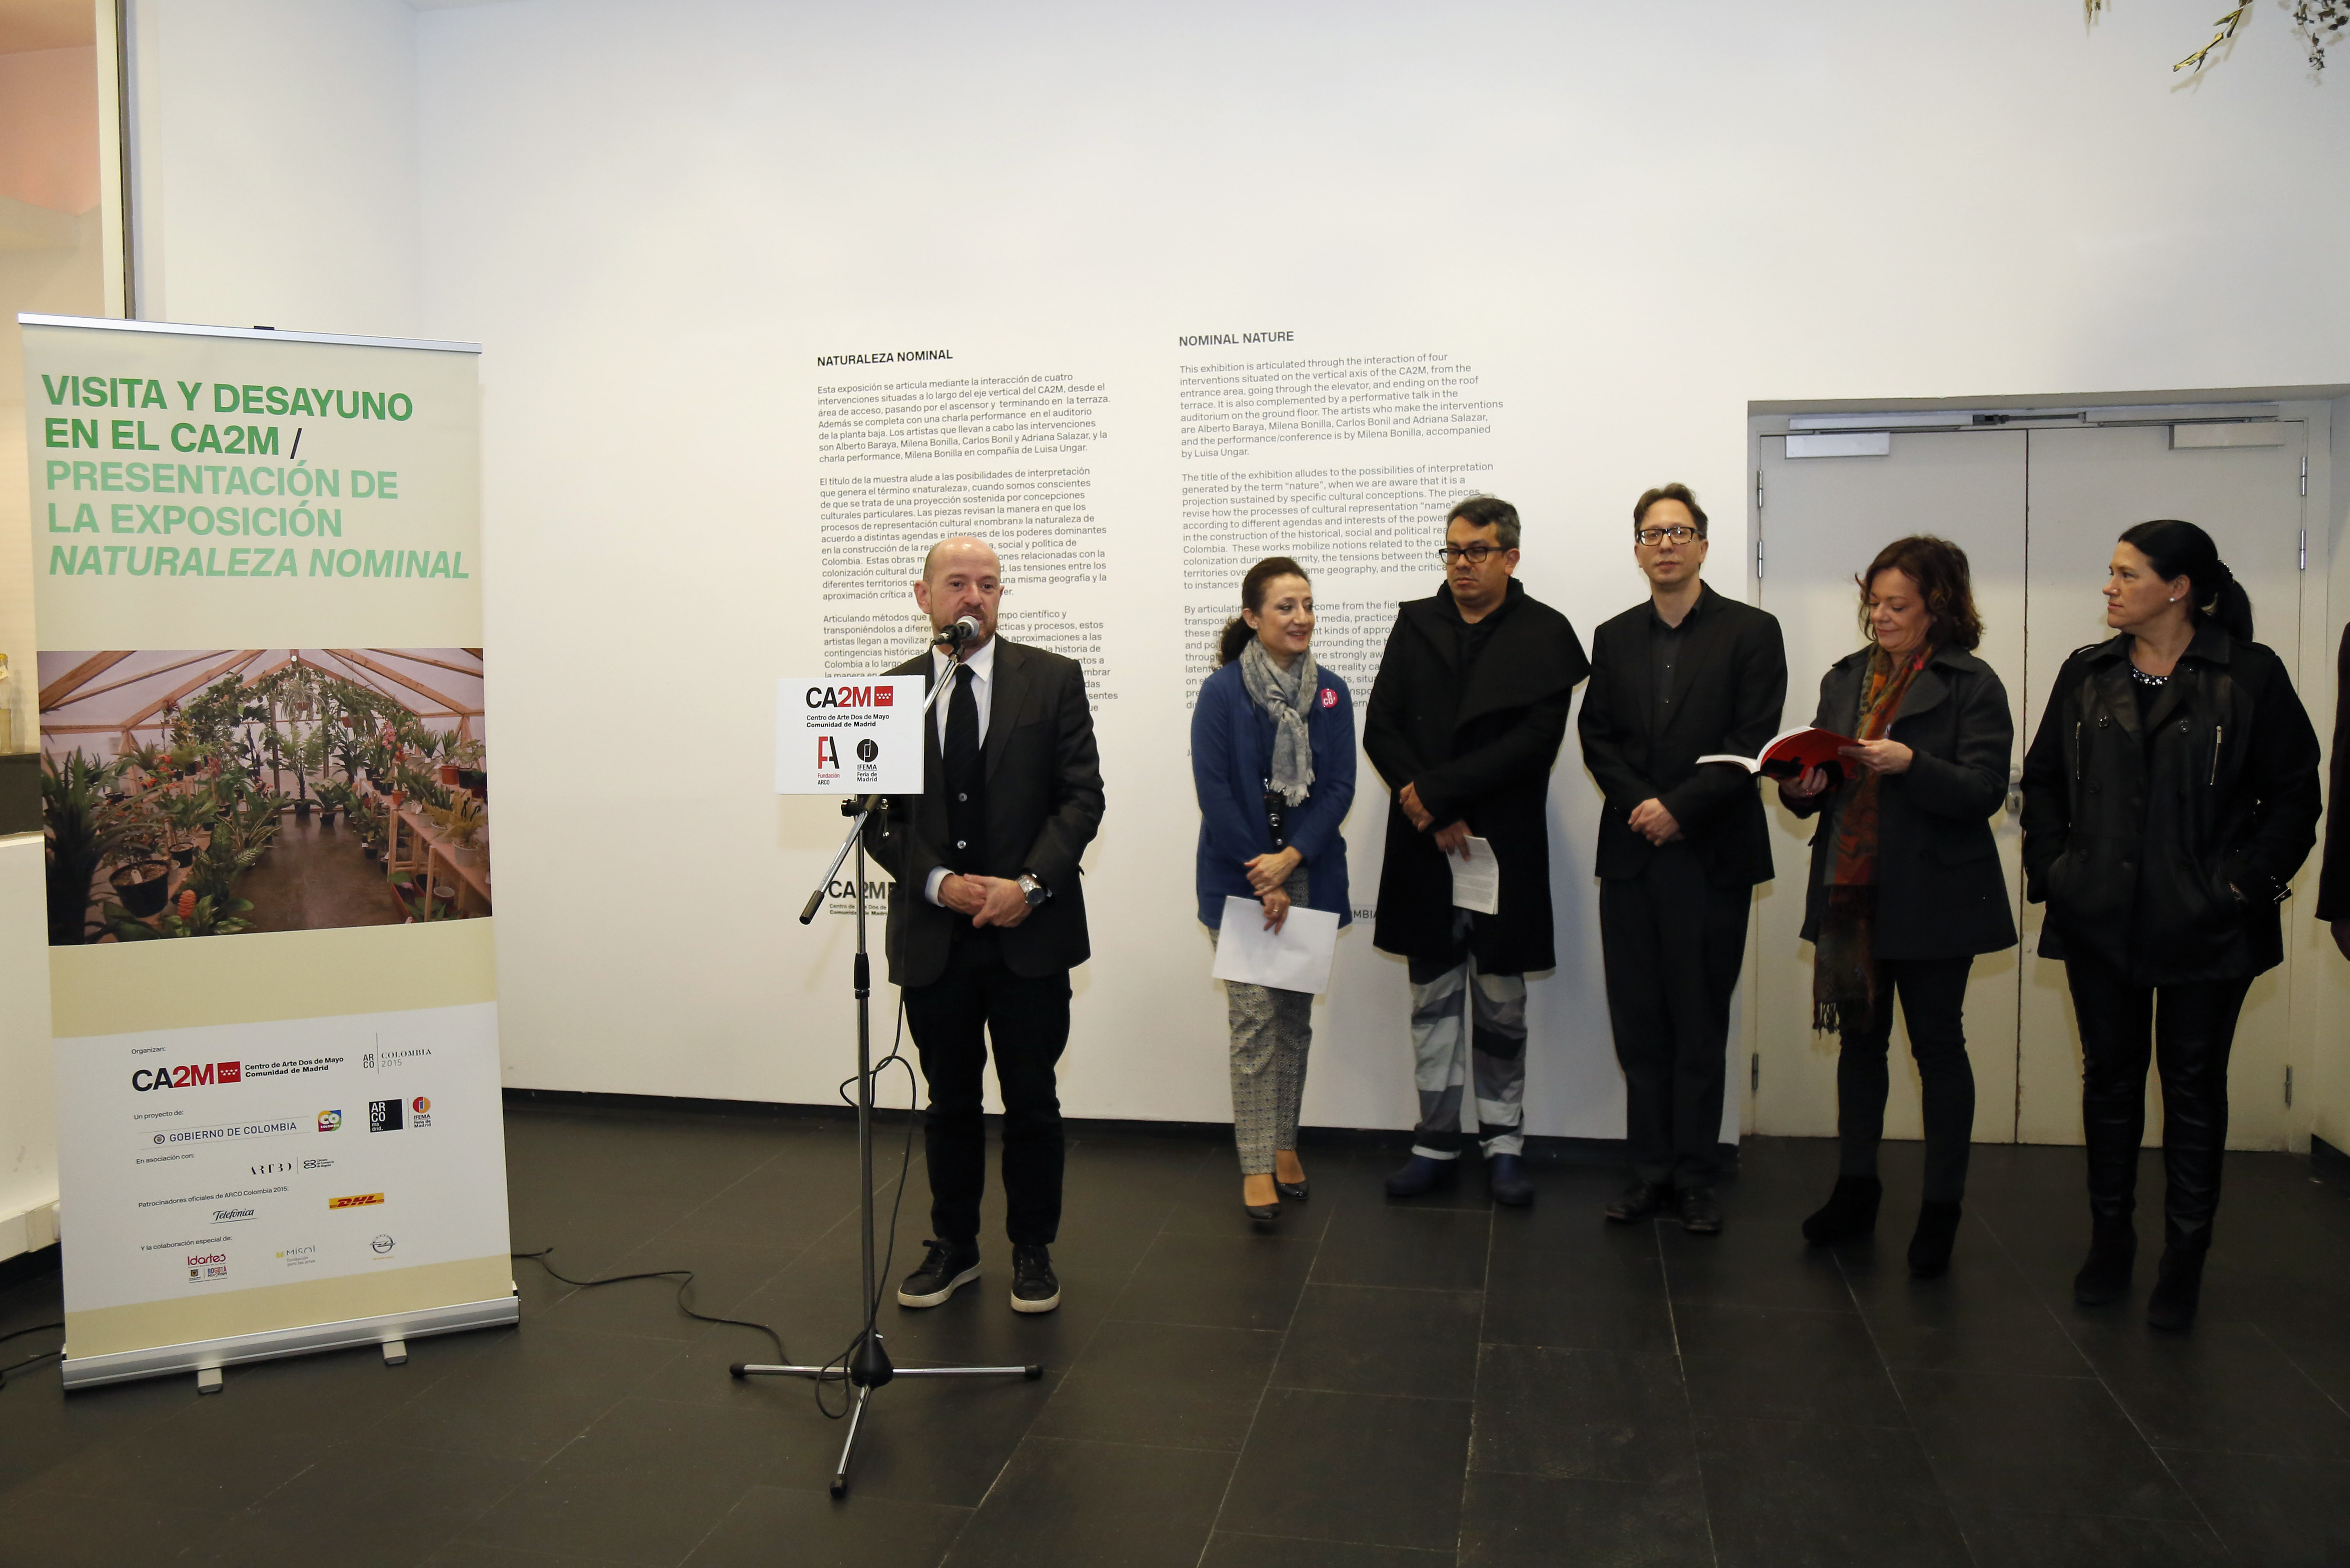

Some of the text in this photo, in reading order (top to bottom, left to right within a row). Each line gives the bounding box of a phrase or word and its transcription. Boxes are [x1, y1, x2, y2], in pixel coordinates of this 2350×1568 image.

[1179, 331, 1294, 346] NOMINAL NATURE
[818, 349, 953, 366] NATURALEZA NOMINAL
[1179, 353, 1448, 373] This exhibition is articulated through the interaction of four
[818, 386, 835, 394] Esta
[837, 383, 882, 394] exposición
[896, 381, 927, 390] articula
[929, 379, 969, 388] mediante
[981, 375, 1029, 385] interacción
[1031, 374, 1042, 383] de
[1044, 373, 1073, 382] cuatro
[41, 374, 413, 422] VISITA Y DESAYUNO
[45, 417, 98, 449] EN
[112, 419, 160, 451] EL
[171, 422, 279, 455] CA2M
[1181, 425, 1491, 446] and the performance/conference is by Milena Bonilla, accompanied
[1182, 448, 1249, 459] by Luisa Ungar.
[46, 459, 398, 499] PRESENTACIÓN DE
[820, 477, 827, 486] El
[829, 477, 850, 485] título
[851, 476, 862, 484] de
[873, 475, 908, 483] muestra
[909, 473, 933, 482] alude
[942, 473, 954, 481] las
[956, 470, 1013, 482] posibilidades
[1015, 469, 1026, 477] de
[1028, 466, 1090, 478] interpretación
[47, 500, 342, 537] LA EXPOSICIÓN
[49, 544, 469, 579] NATURALEZA NOMINAL
[1342, 602, 1364, 610] from
[1366, 601, 1381, 609] the
[823, 613, 927, 623] Articulando métodos que
[824, 638, 855, 646] artistas
[857, 637, 882, 647] llegan
[806, 686, 871, 709] CA2M
[131, 1047, 166, 1055] Organizan:
[381, 1049, 431, 1059] COLOMBIA
[132, 1063, 214, 1092] CA2M
[245, 1068, 288, 1077] Comunidad
[144, 1111, 173, 1120] proyecto
[170, 1122, 297, 1142] GOBIERNO DE COLOMBIA
[145, 1155, 180, 1163] asociación
[138, 1198, 187, 1208] Patrocinadores
[337, 1196, 377, 1207] DHL
[212, 1208, 255, 1221] Telefónica
[153, 1240, 194, 1249] colaboración
[195, 1236, 222, 1245] especial
[188, 1254, 226, 1265] Idartes
